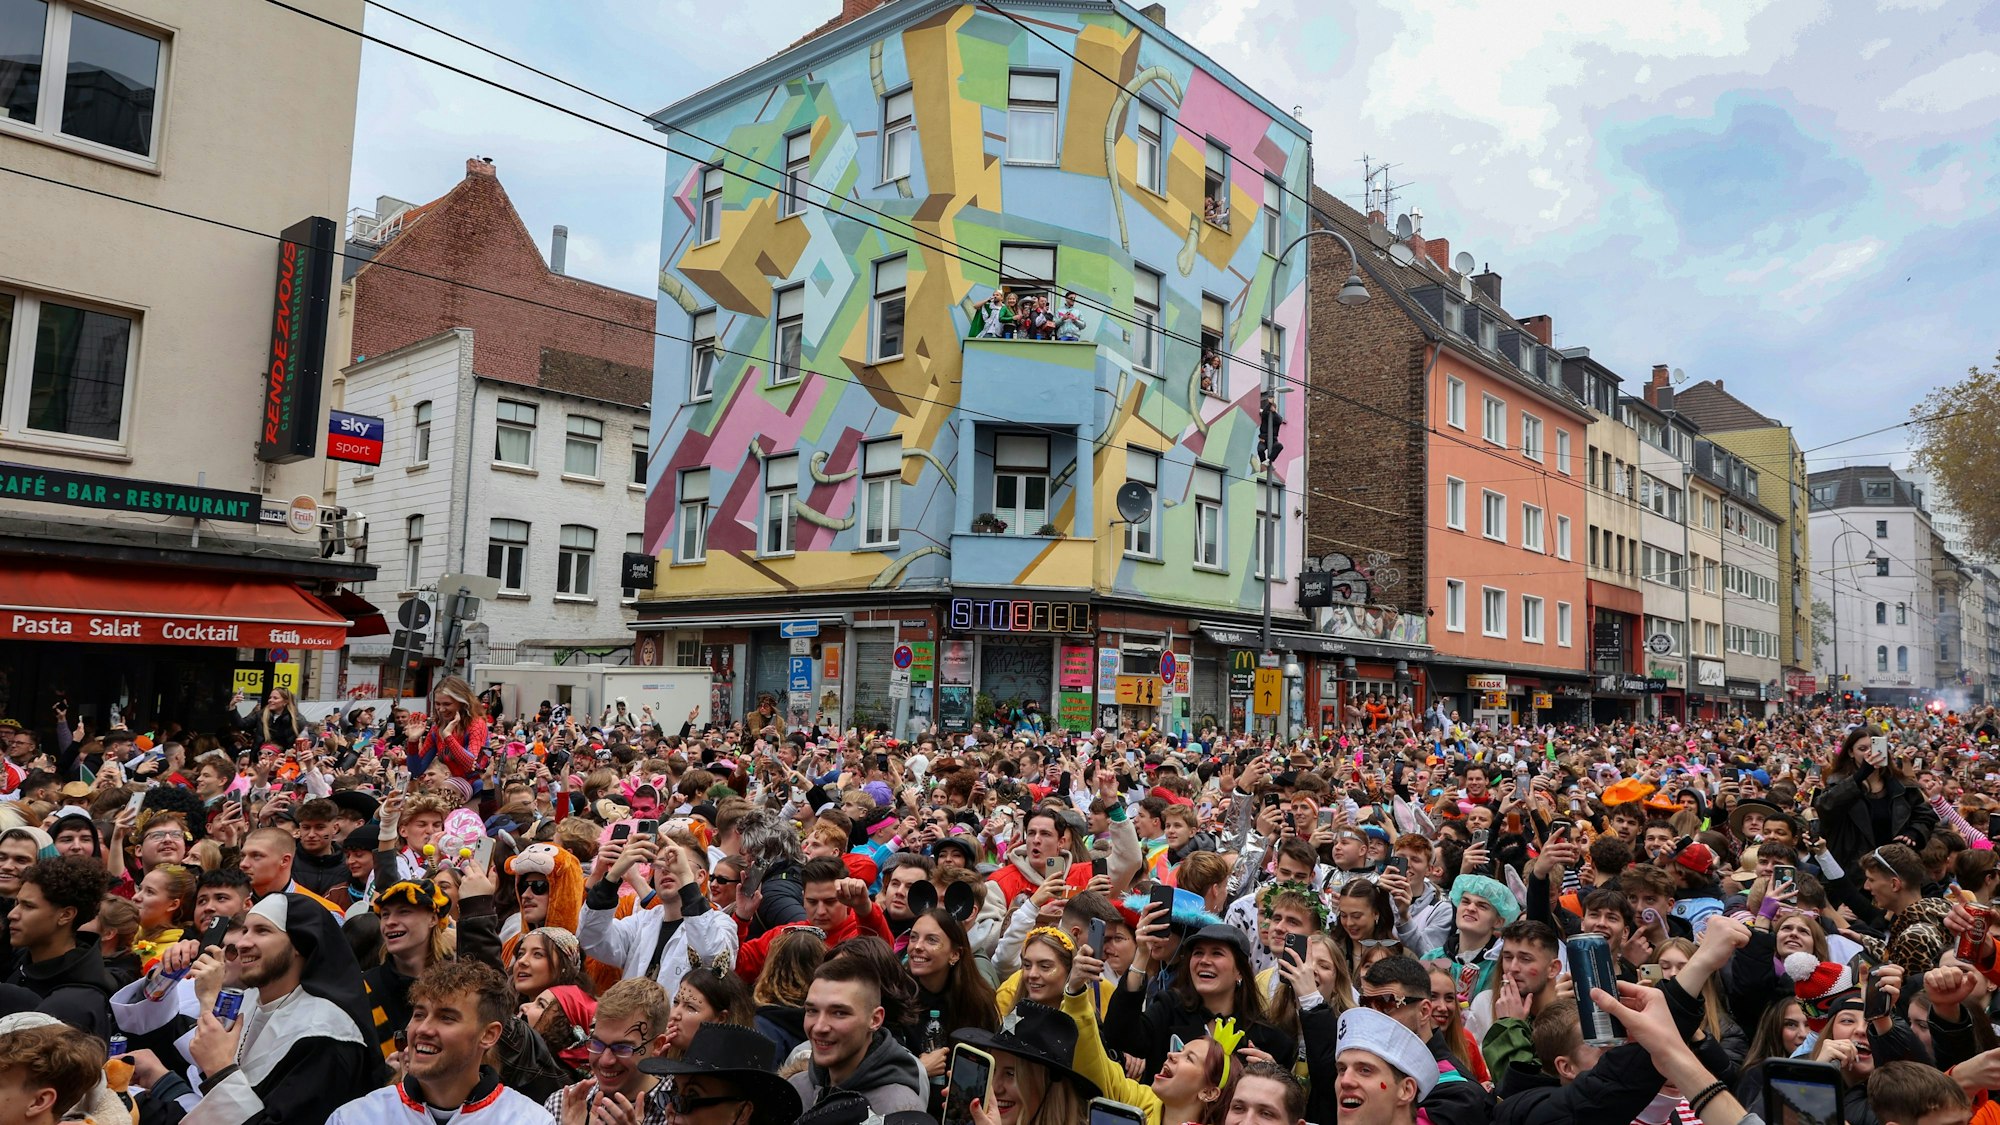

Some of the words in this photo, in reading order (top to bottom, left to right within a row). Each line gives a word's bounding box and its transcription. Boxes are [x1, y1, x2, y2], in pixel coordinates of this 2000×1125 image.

[286, 353, 296, 381] BAR
[291, 248, 305, 341] RESTAURANT
[340, 417, 370, 437] sky
[335, 441, 371, 457] sport
[67, 482, 107, 503] BAR
[126, 488, 250, 518] RESTAURANT
[954, 601, 1087, 630] STIEFEL
[12, 614, 73, 635] Pasta
[88, 618, 142, 638] Salat
[162, 621, 239, 642] Cocktail
[269, 628, 300, 646] früh
[792, 659, 803, 673] P
[1262, 674, 1275, 684] U1
[1649, 681, 1665, 690] sky
[655, 701, 660, 710] 3
